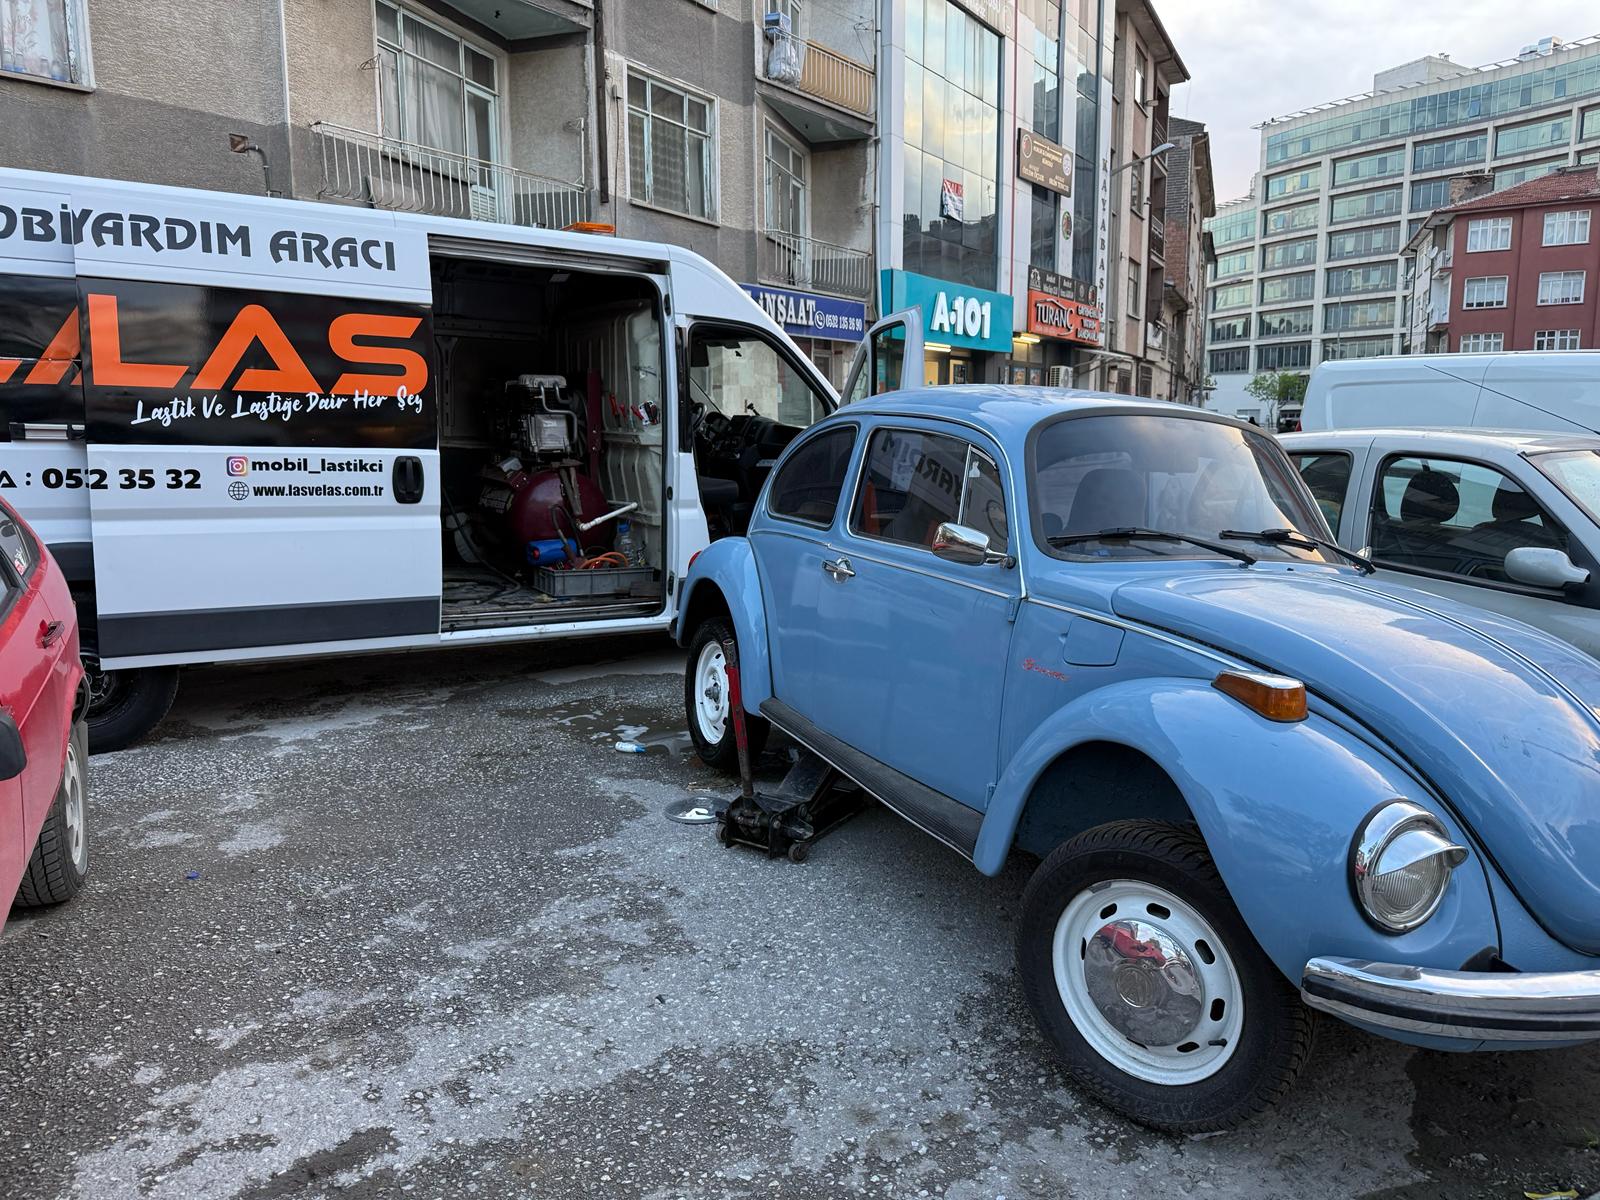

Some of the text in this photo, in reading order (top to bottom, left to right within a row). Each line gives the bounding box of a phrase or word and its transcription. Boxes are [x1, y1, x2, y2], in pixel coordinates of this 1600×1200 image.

[269, 230, 396, 271] ARACI
[131, 385, 423, 427] Lastik Ve Lastiğe Dair Her Şey
[252, 458, 383, 474] mobil_lastikci
[253, 485, 383, 497] www.lasvelas.com.tr
